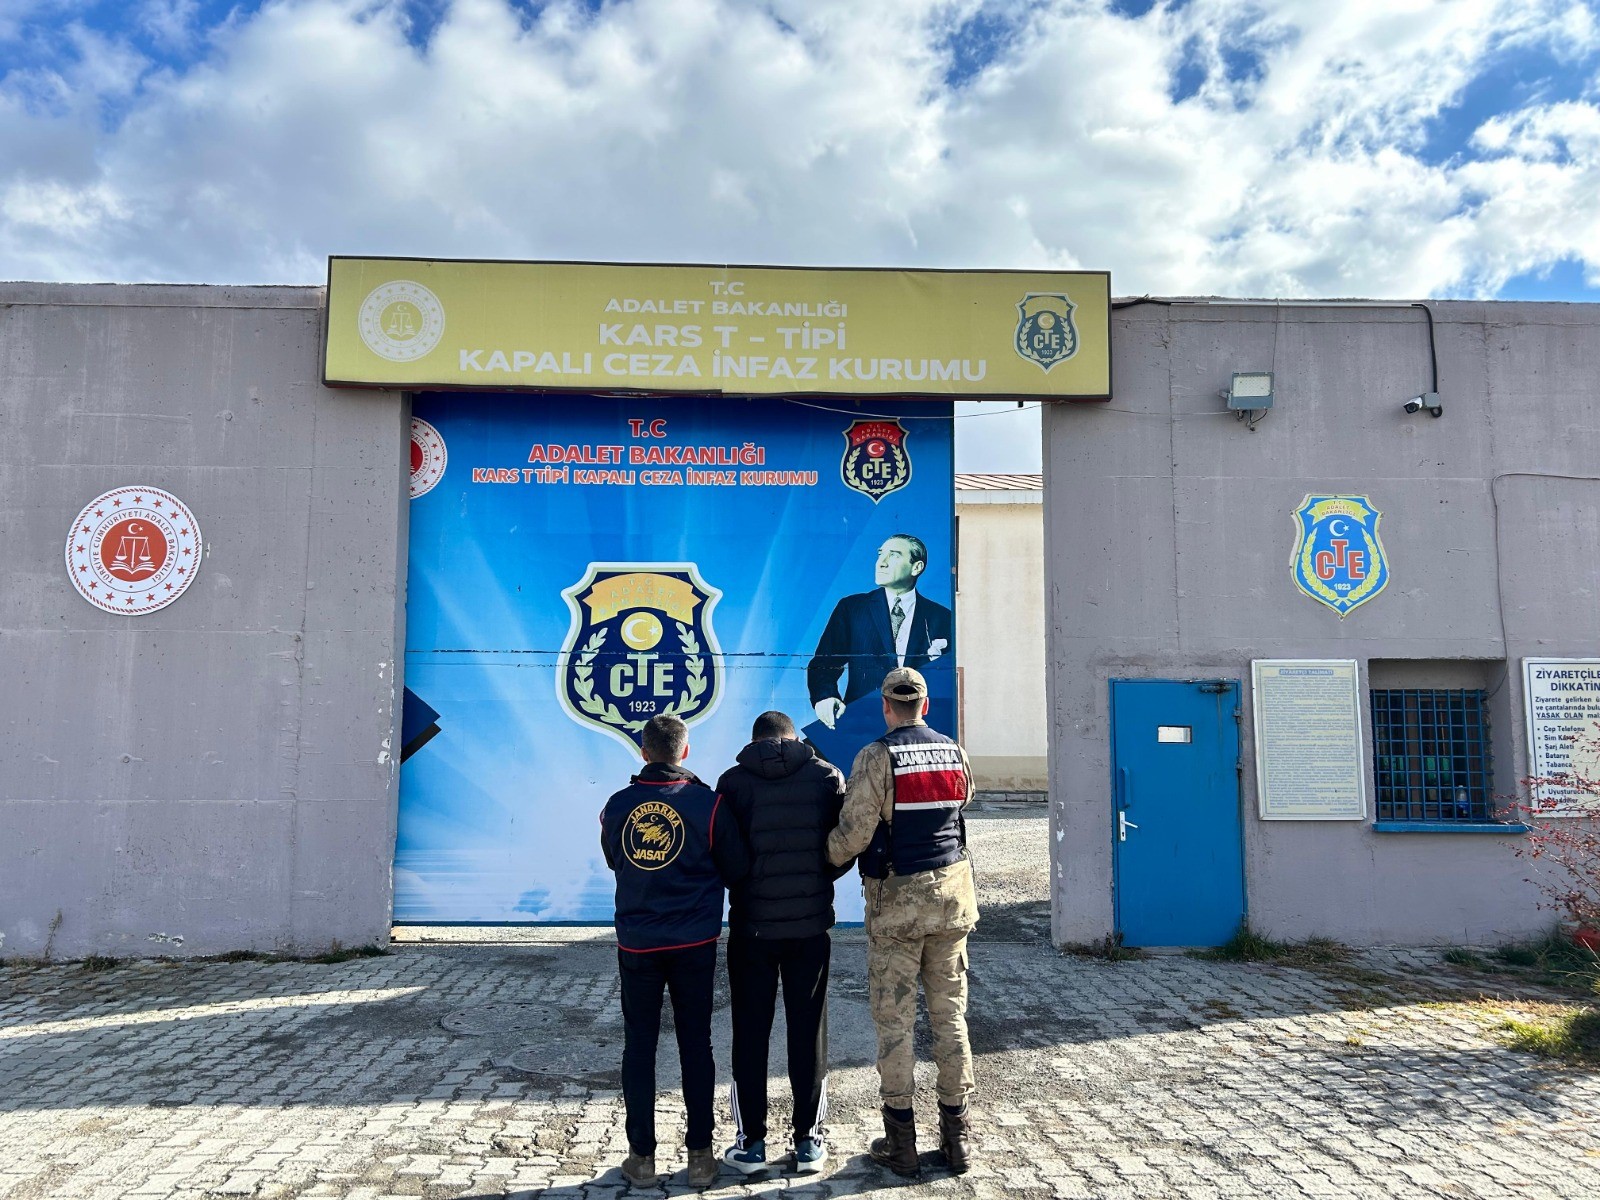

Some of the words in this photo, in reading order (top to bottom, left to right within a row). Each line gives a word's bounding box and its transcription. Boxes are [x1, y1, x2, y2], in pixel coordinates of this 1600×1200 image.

[709, 281, 745, 296] T.C
[604, 298, 705, 314] ADALET
[711, 300, 848, 318] BAKANLIĞI
[599, 323, 703, 348] KARS
[713, 326, 739, 349] T
[776, 321, 846, 350] TİPİ
[1033, 329, 1060, 349] CTE
[459, 349, 592, 375] KAPALI
[602, 353, 702, 377] CEZA
[712, 349, 818, 379] İNFAZ
[829, 357, 987, 382] KURUMU
[628, 418, 667, 438] T.C
[527, 444, 625, 465] ADALET
[630, 442, 766, 466] BAKANLIĞI
[472, 467, 520, 484] KARS
[522, 468, 534, 484] T
[535, 465, 570, 485] TİPİ
[573, 468, 636, 486] KAPALI
[640, 469, 682, 486] CEZA
[686, 467, 737, 487] İNFAZ
[740, 470, 818, 487] KURUMU
[862, 457, 892, 479] CTE
[93, 510, 143, 549] CUMHURİYETİ
[144, 512, 172, 537] ADALET
[92, 550, 115, 585] TÜRKİYE
[152, 538, 175, 584] BAKANLIĞI
[1316, 539, 1366, 580] CTE
[1333, 583, 1352, 591] 1923
[609, 652, 674, 698] CTE
[628, 700, 657, 713] 1923
[1545, 704, 1585, 712] çantalarında
[896, 750, 959, 767] JANDARMA
[630, 803, 681, 828] JANDARMA
[632, 849, 668, 861] JASAT
